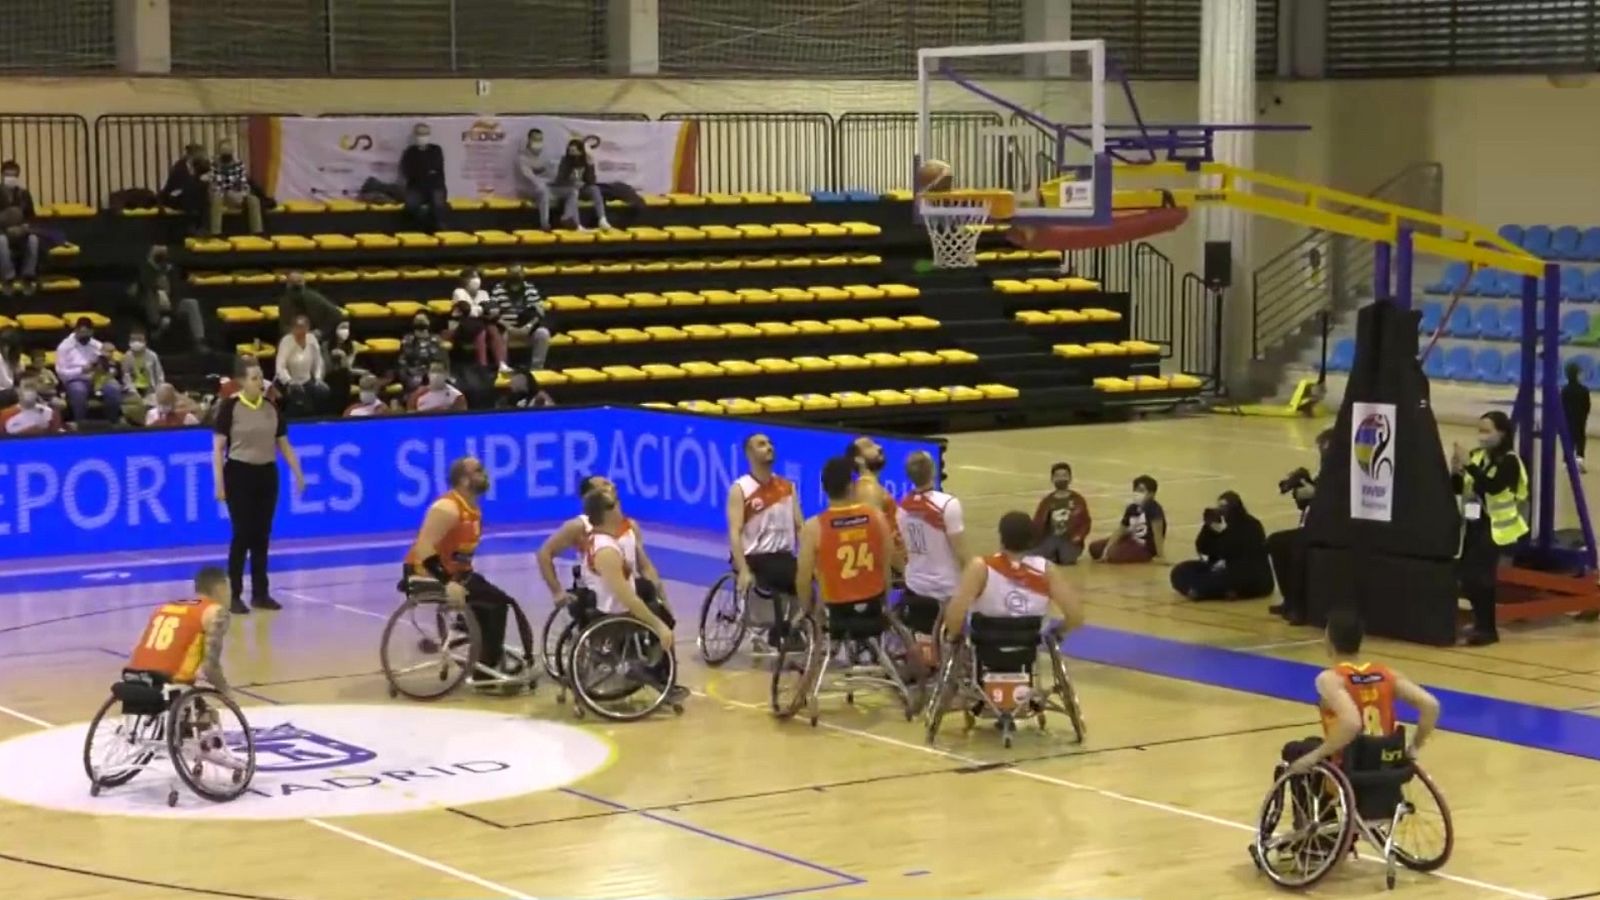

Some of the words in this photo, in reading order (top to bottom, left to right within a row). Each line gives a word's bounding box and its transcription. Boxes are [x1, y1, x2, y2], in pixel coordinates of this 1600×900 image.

[289, 442, 363, 515] ES
[836, 542, 874, 579] 24
[145, 615, 180, 651] 16
